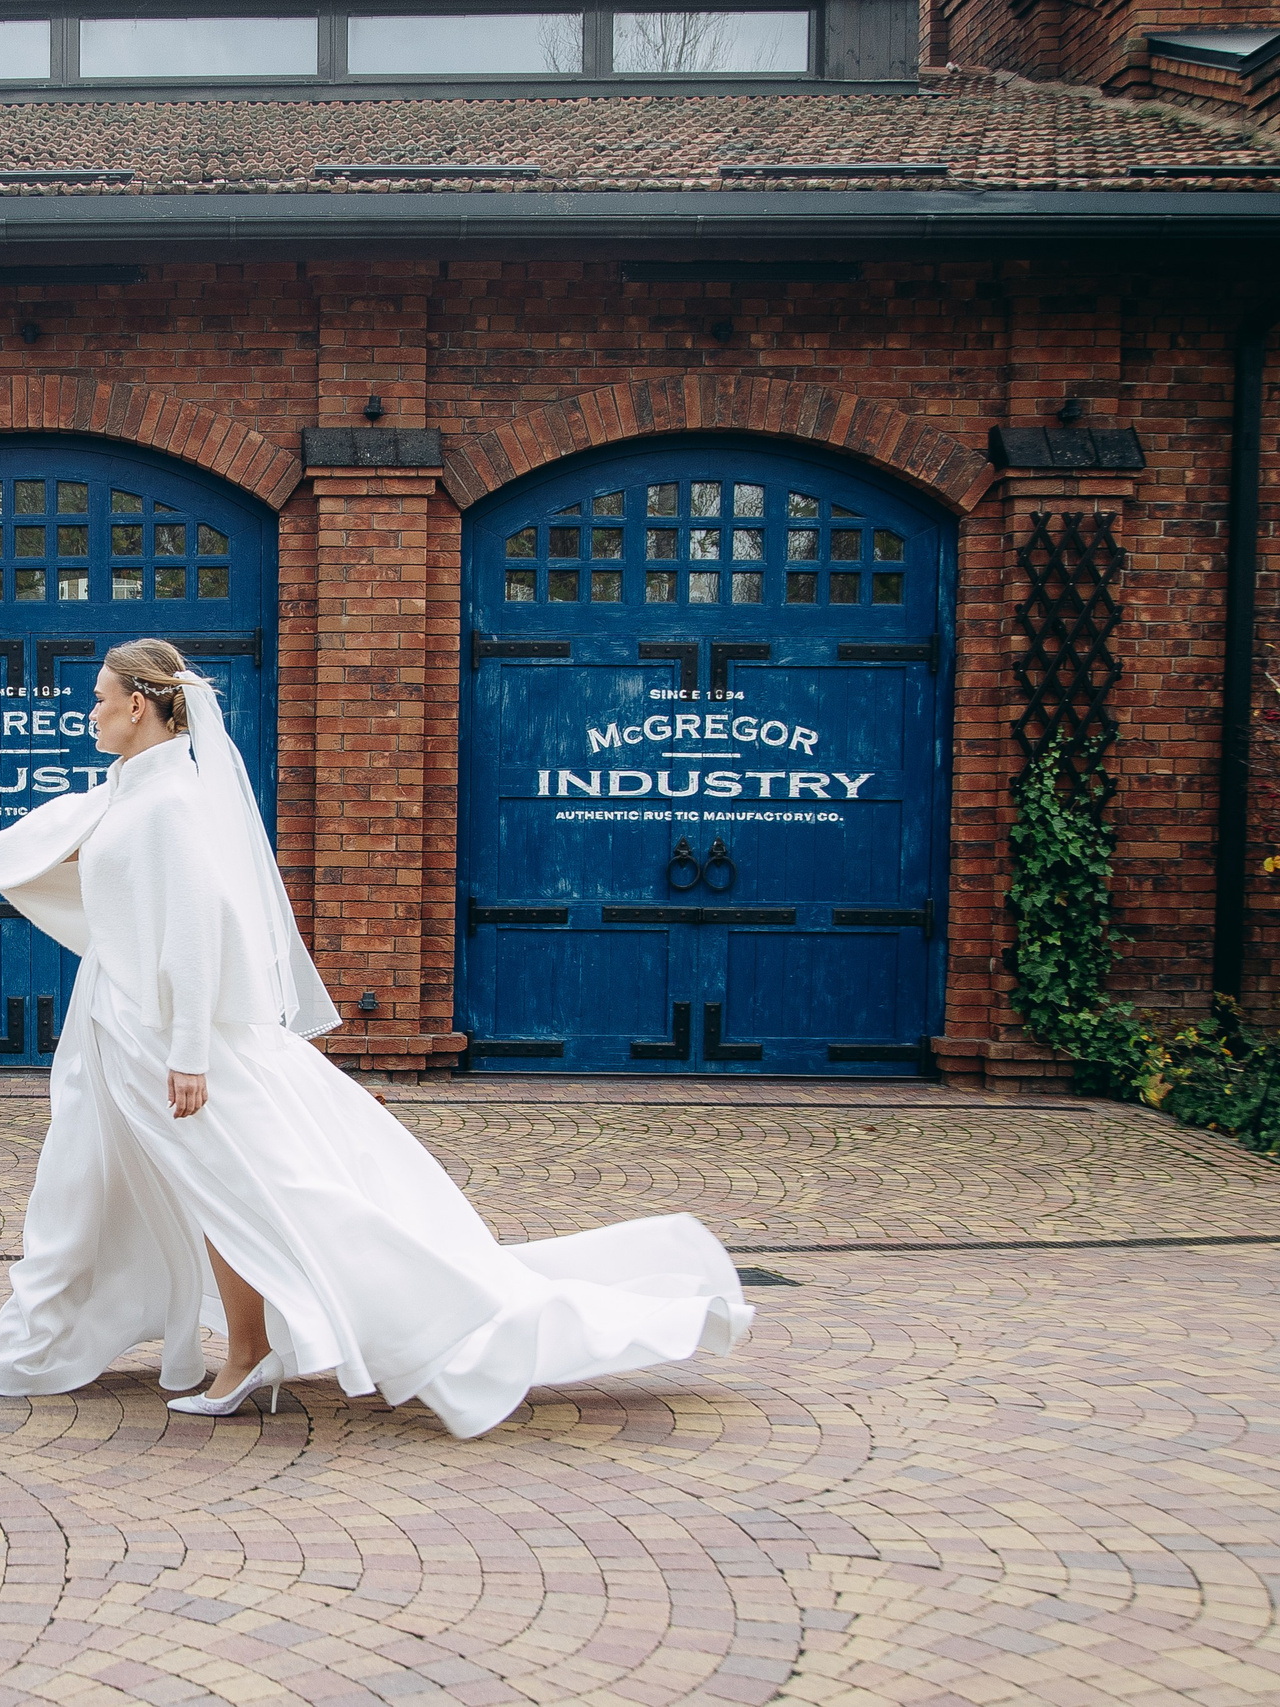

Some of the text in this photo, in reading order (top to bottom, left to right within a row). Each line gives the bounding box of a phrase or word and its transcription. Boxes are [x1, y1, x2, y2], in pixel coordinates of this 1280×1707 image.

[33, 685, 72, 697] 1894
[649, 688, 745, 701] SINCE 1894
[586, 714, 820, 756] McGREGOR
[536, 770, 876, 798] INDUSTRY
[555, 811, 844, 821] AUTHENTIC RUSTIC MANUFACTORY CO.
